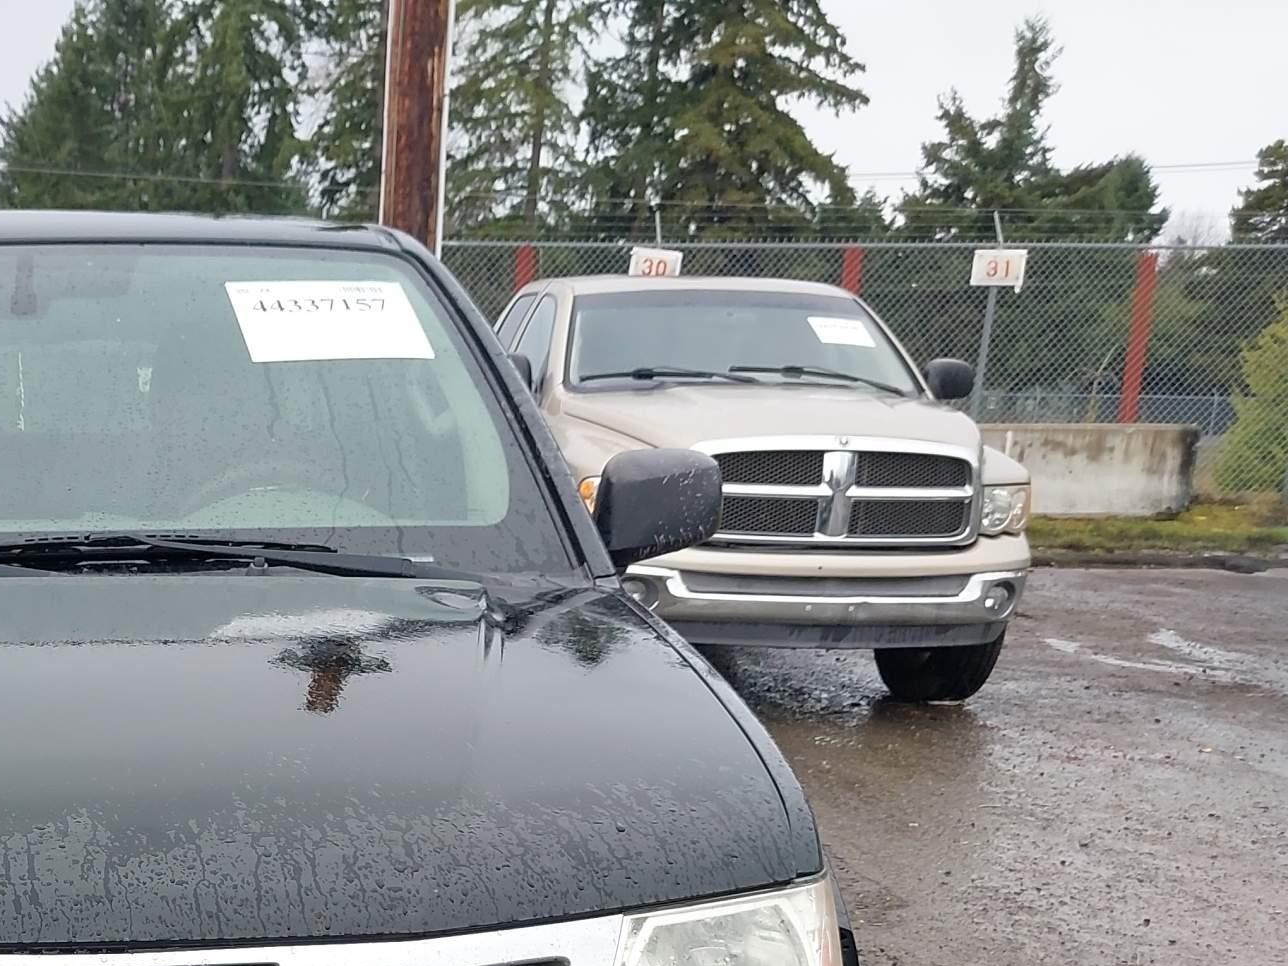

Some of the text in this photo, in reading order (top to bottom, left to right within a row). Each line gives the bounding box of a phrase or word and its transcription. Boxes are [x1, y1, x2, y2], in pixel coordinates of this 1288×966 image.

[641, 256, 667, 277] 30
[985, 259, 1010, 278] 31
[252, 298, 386, 313] 44337157
